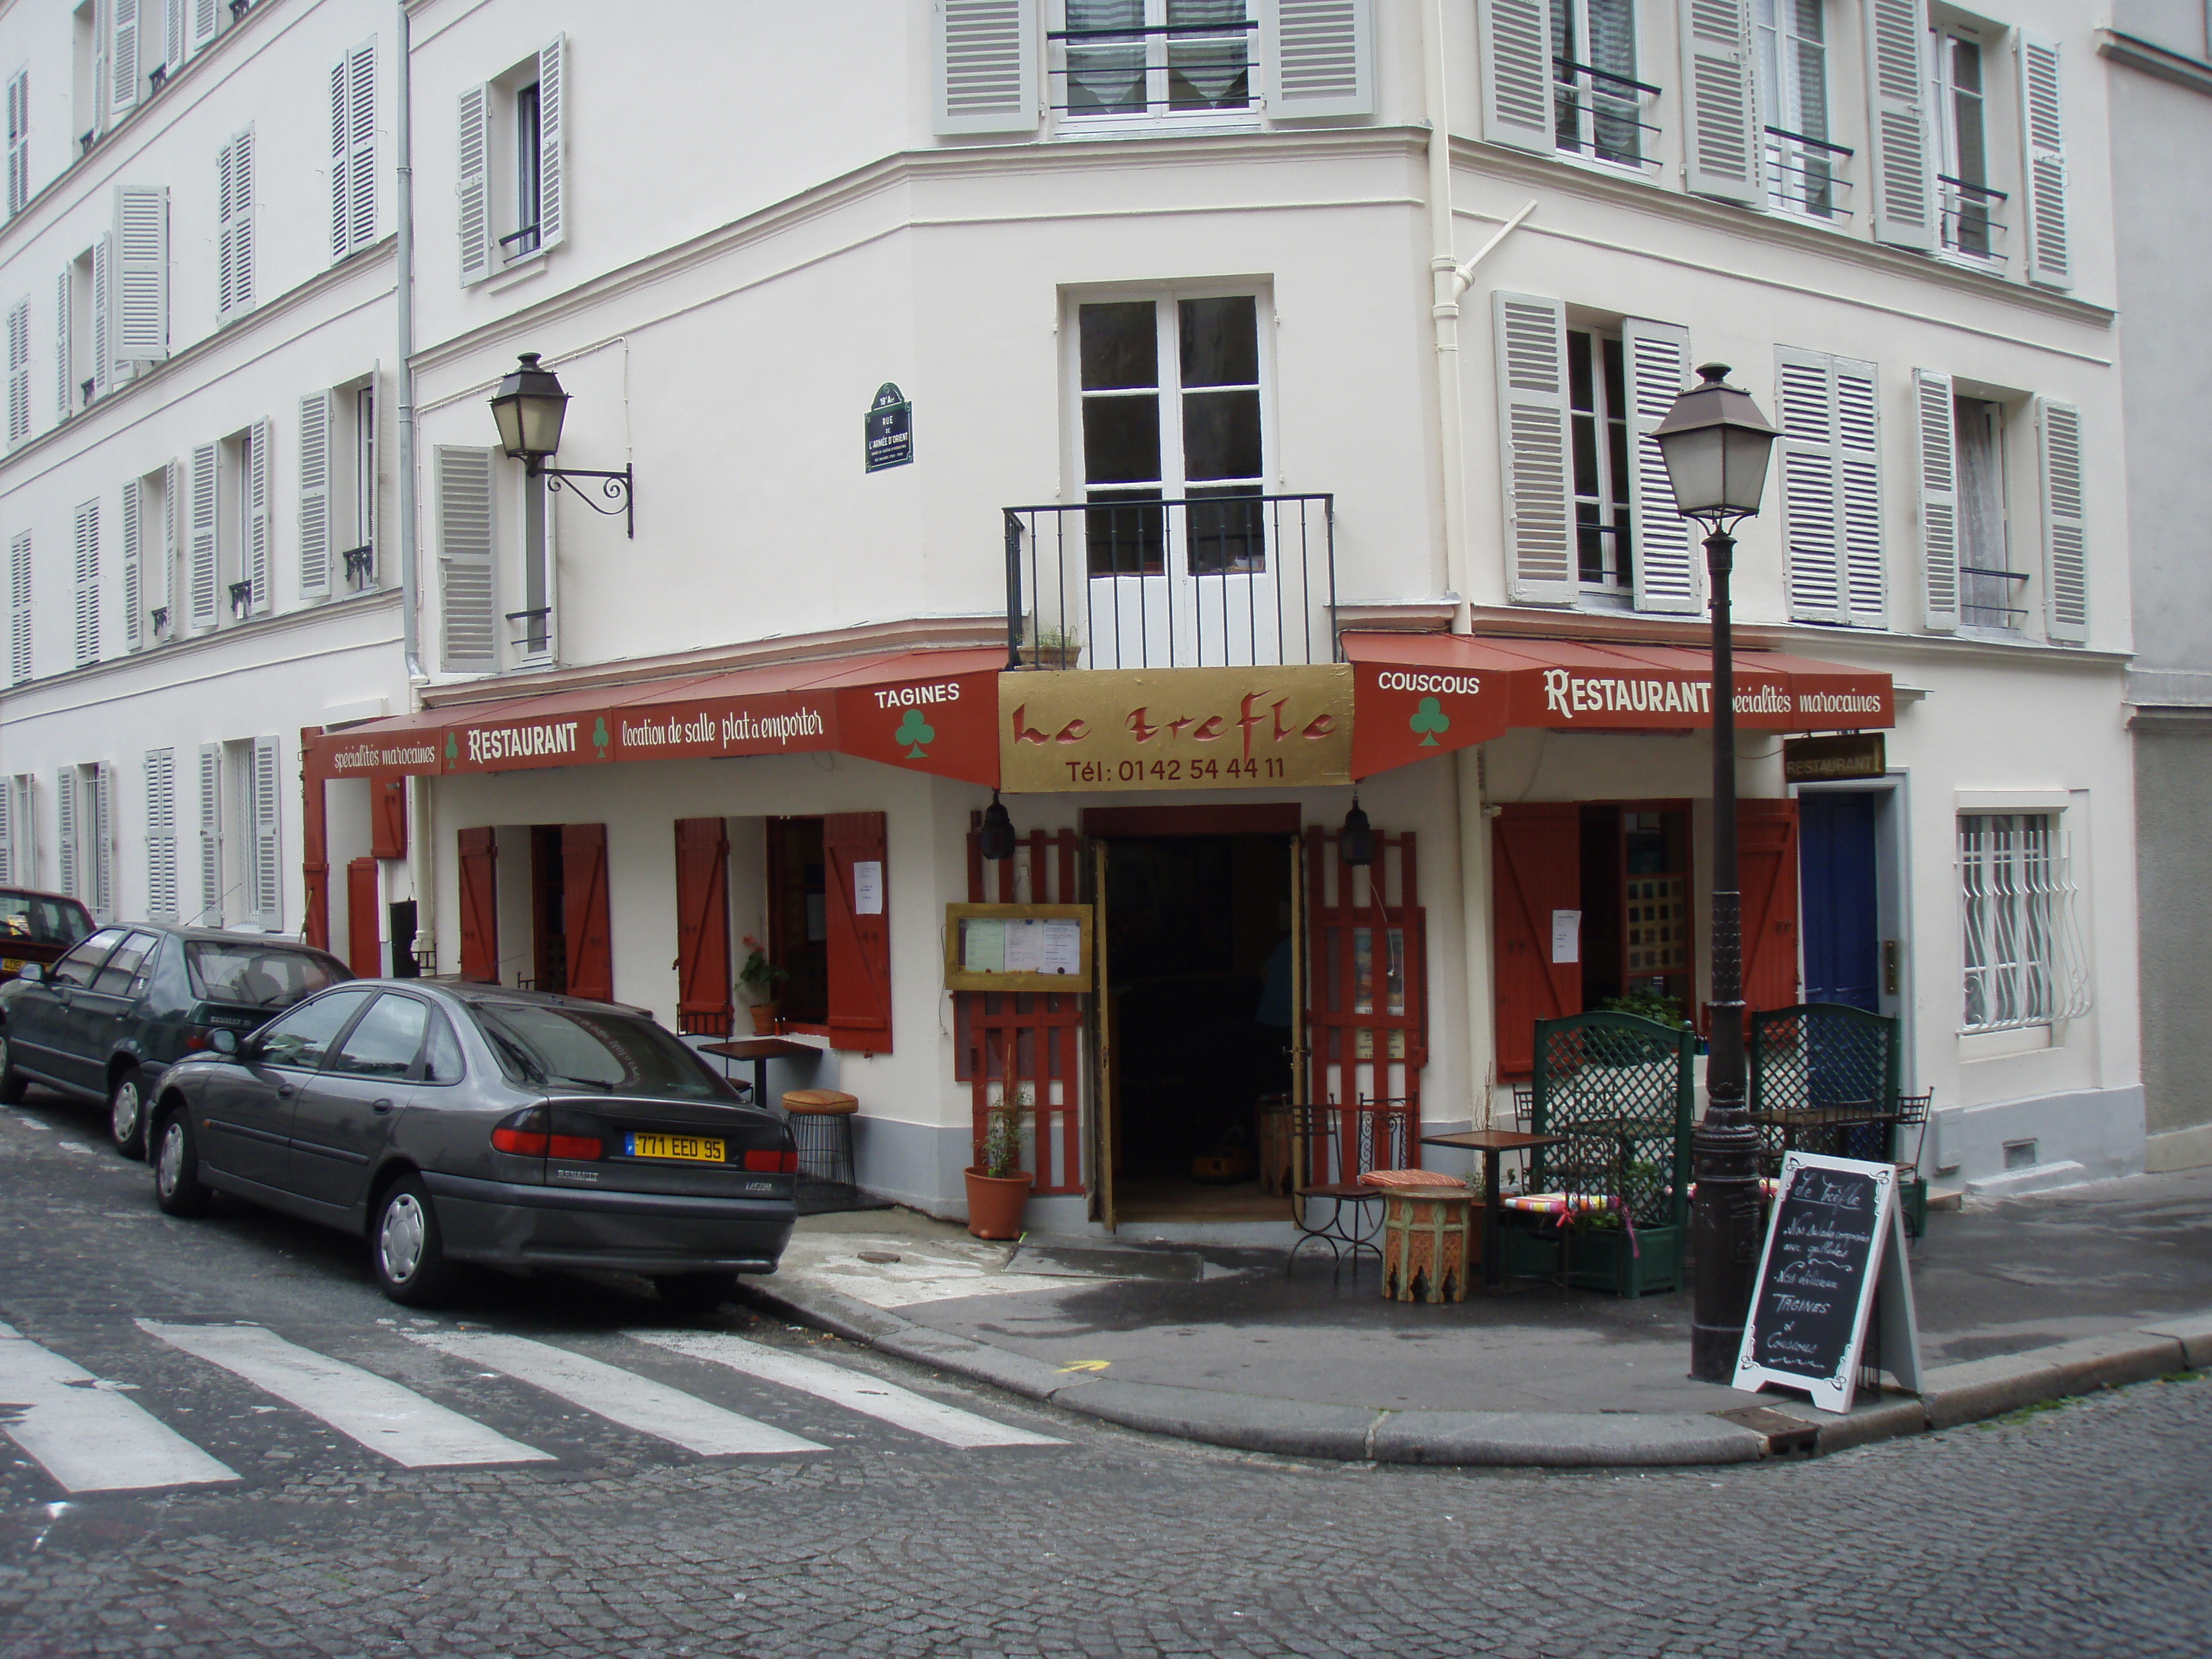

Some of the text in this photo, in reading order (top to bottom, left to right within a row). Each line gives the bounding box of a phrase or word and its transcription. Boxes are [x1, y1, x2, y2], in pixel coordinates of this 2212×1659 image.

[882, 415, 894, 426] RUE
[868, 436, 888, 449] L'ARMÉE
[1378, 672, 1480, 694] COUSCOUS
[1542, 669, 1881, 719] RESTAURANT écialités marocaines
[874, 683, 960, 709] TAGINES
[335, 706, 824, 773] spécialités marocaines RESTAURANT location de salle plat à emporter
[1118, 760, 1143, 781] 01
[1150, 760, 1181, 781] 42
[1190, 759, 1218, 780] 54
[1226, 758, 1258, 778] 44
[1265, 757, 1284, 777] 11
[1786, 756, 1873, 774] RESTAURANT
[639, 1136, 665, 1154] 771
[672, 1138, 698, 1156] EED
[704, 1141, 721, 1159] 95
[557, 1169, 598, 1182] RENAULT
[1773, 1293, 1830, 1313] TAGINES
